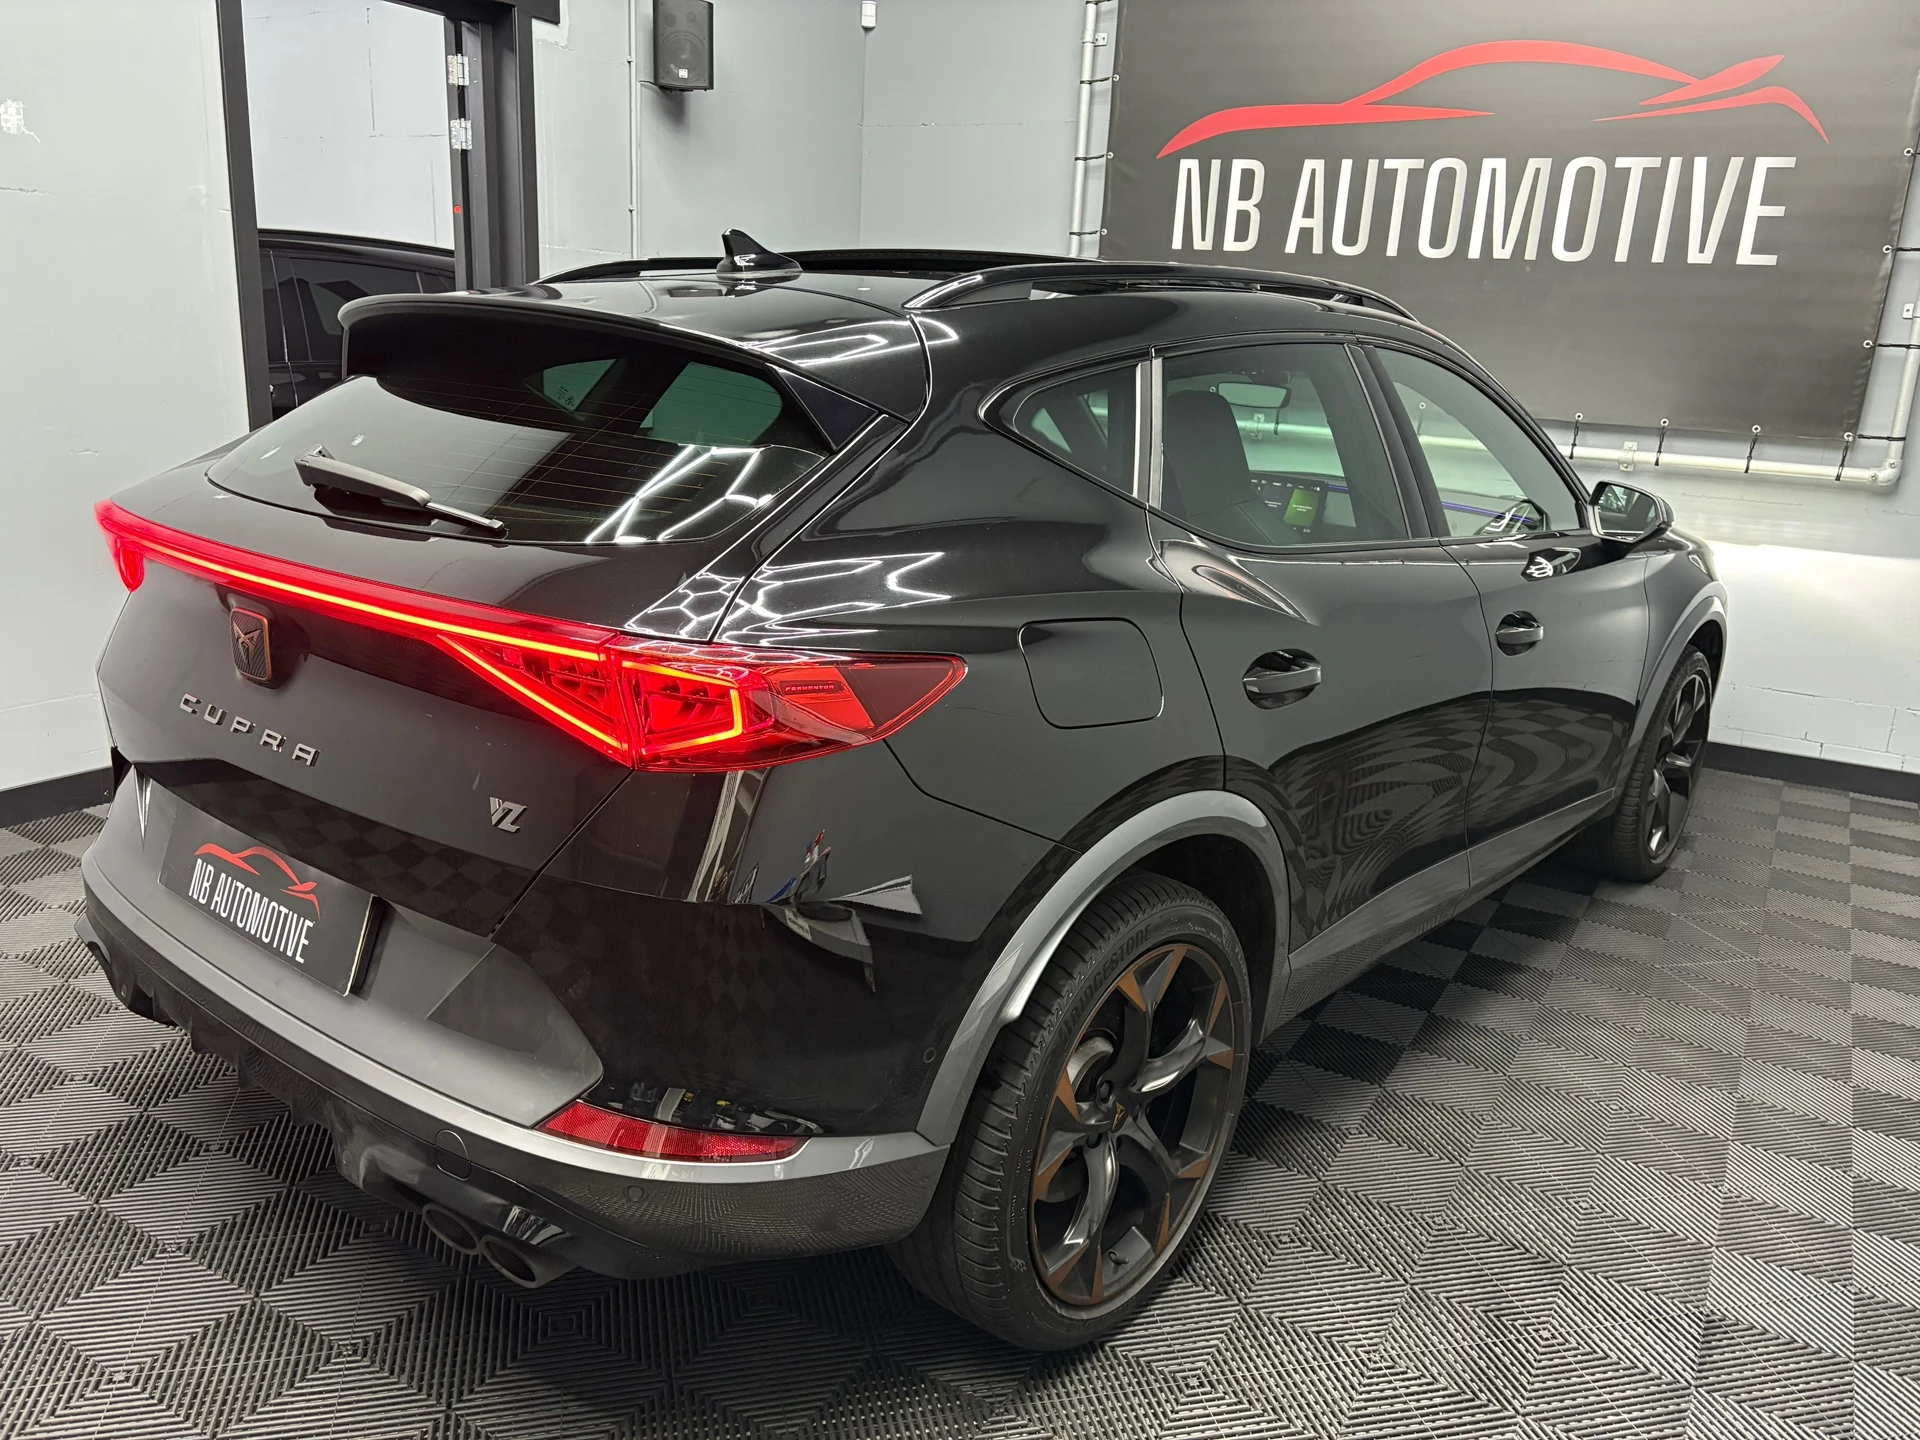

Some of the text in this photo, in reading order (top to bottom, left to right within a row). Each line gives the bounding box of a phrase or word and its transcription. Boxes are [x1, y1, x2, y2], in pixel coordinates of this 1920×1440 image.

[1171, 156, 1797, 266] NB AUTOMOTIVE
[179, 693, 321, 767] CUPRA
[188, 858, 315, 964] NB AUTOMOTIVE
